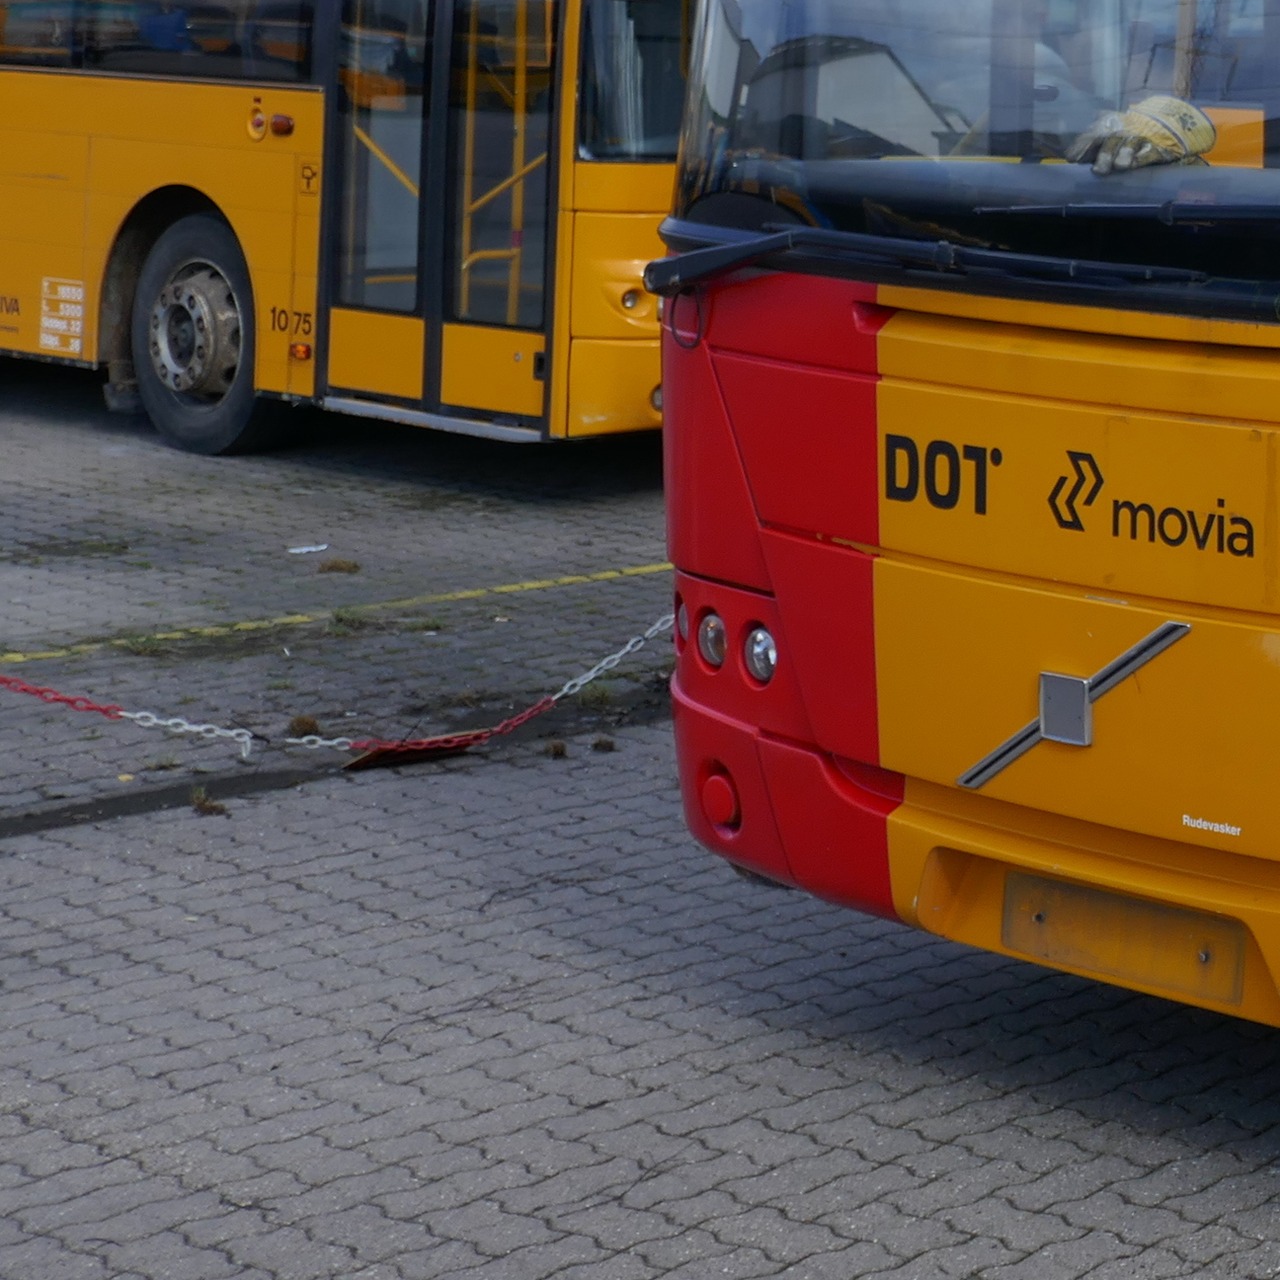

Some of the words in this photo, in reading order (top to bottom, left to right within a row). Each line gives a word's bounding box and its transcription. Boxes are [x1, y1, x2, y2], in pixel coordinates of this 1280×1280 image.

[270, 306, 312, 336] 1075
[885, 432, 1003, 516] DOT
[1111, 498, 1255, 558] movia
[1182, 813, 1242, 837] Rudevasker
